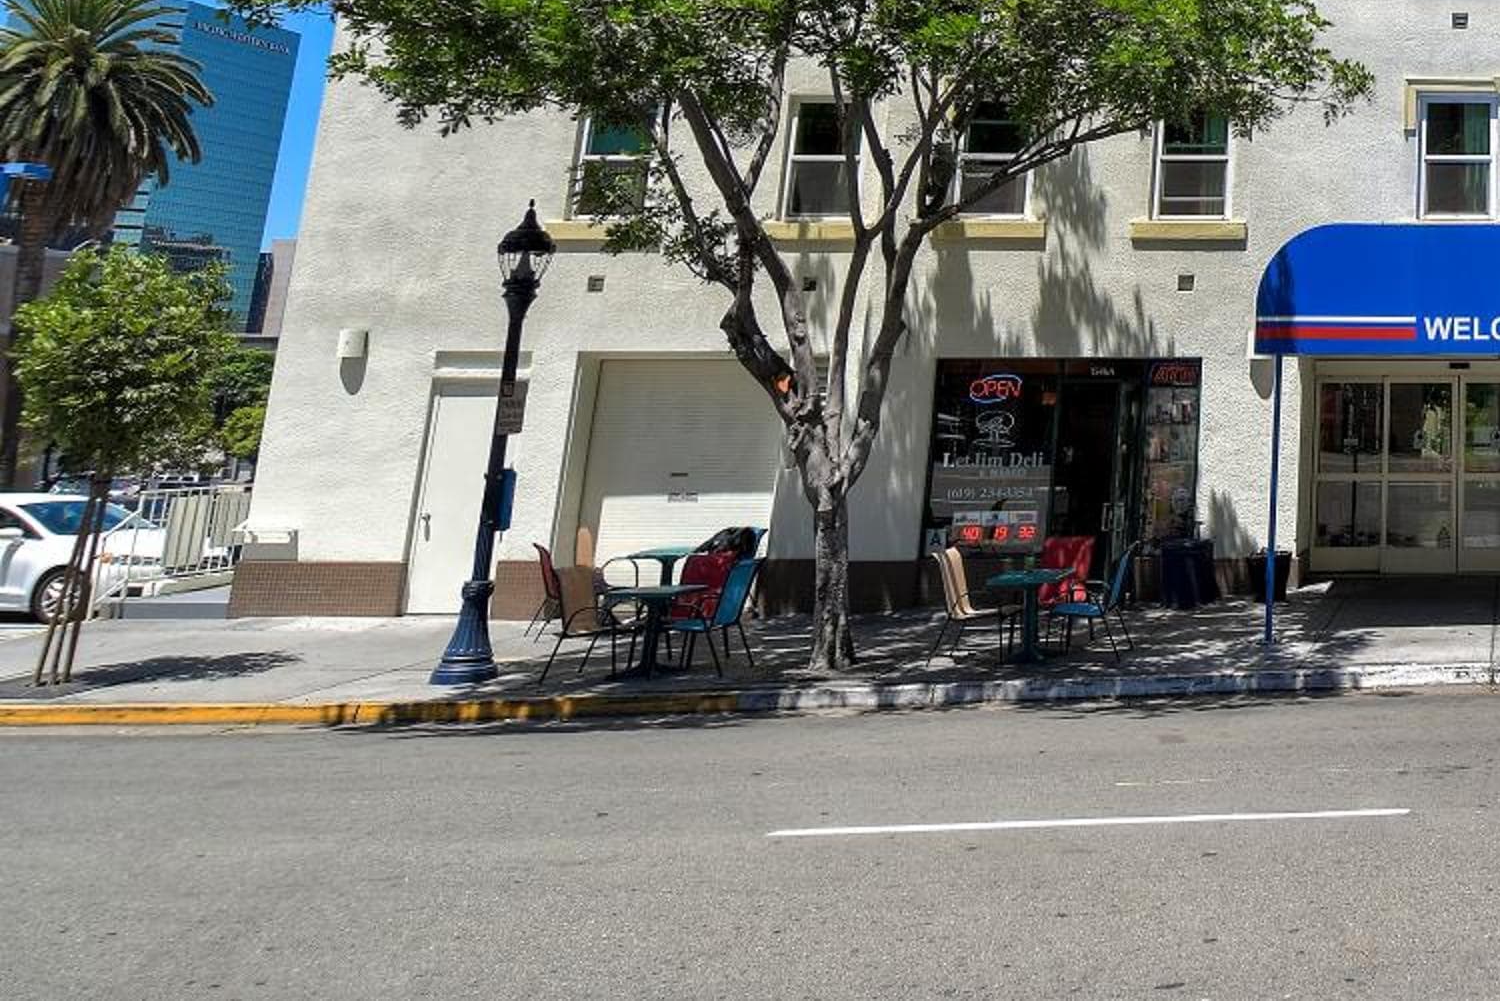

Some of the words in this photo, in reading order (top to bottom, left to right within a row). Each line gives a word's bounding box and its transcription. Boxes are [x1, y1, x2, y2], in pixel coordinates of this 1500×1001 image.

[969, 380, 1022, 397] OPEN
[1009, 452, 1044, 468] Deli
[929, 532, 941, 545] A
